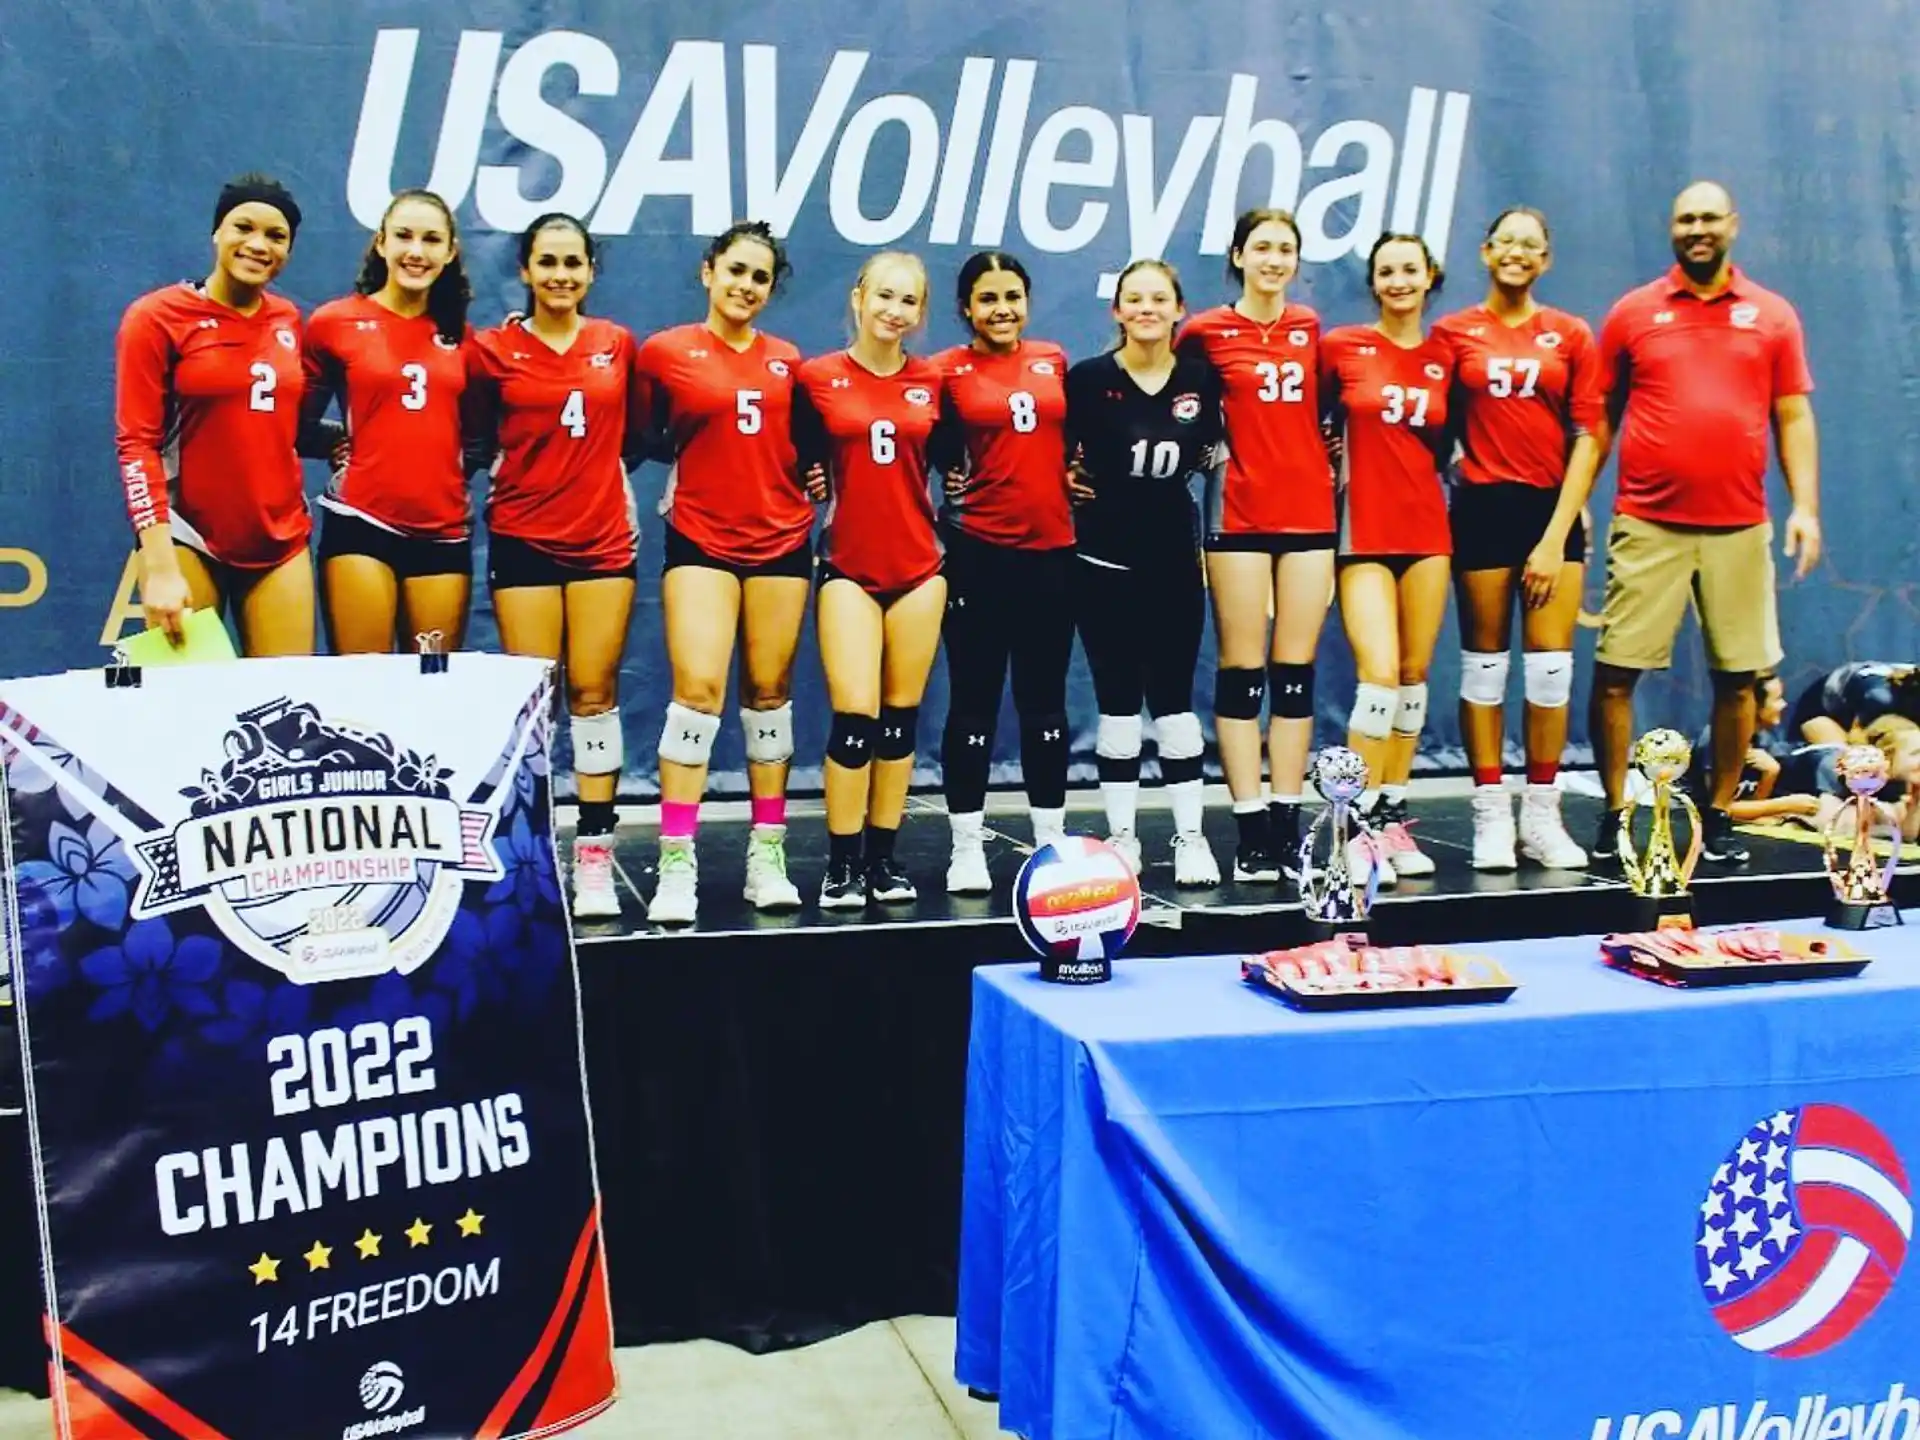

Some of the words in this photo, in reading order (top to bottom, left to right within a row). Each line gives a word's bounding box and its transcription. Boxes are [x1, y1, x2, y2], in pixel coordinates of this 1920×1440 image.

[249, 362, 277, 412] 2
[400, 363, 428, 411] 3
[1255, 361, 1305, 402] 32
[1487, 357, 1541, 399] 57
[560, 389, 587, 438] 4
[736, 389, 763, 435] 5
[1008, 391, 1037, 433] 8
[1380, 385, 1430, 427] 37
[869, 419, 896, 465] 6
[1129, 439, 1181, 479] 10
[257, 773, 314, 800] GIRLS
[318, 770, 387, 793] JUNIOR
[202, 804, 442, 873] NATIONAL
[251, 856, 411, 894] CHAMPIONSHIP
[309, 903, 367, 936] 2022
[266, 1015, 436, 1116] 2022
[154, 1092, 531, 1236] CHAMPIONS
[249, 1305, 300, 1354] 14
[306, 1257, 500, 1341] FREEDOM
